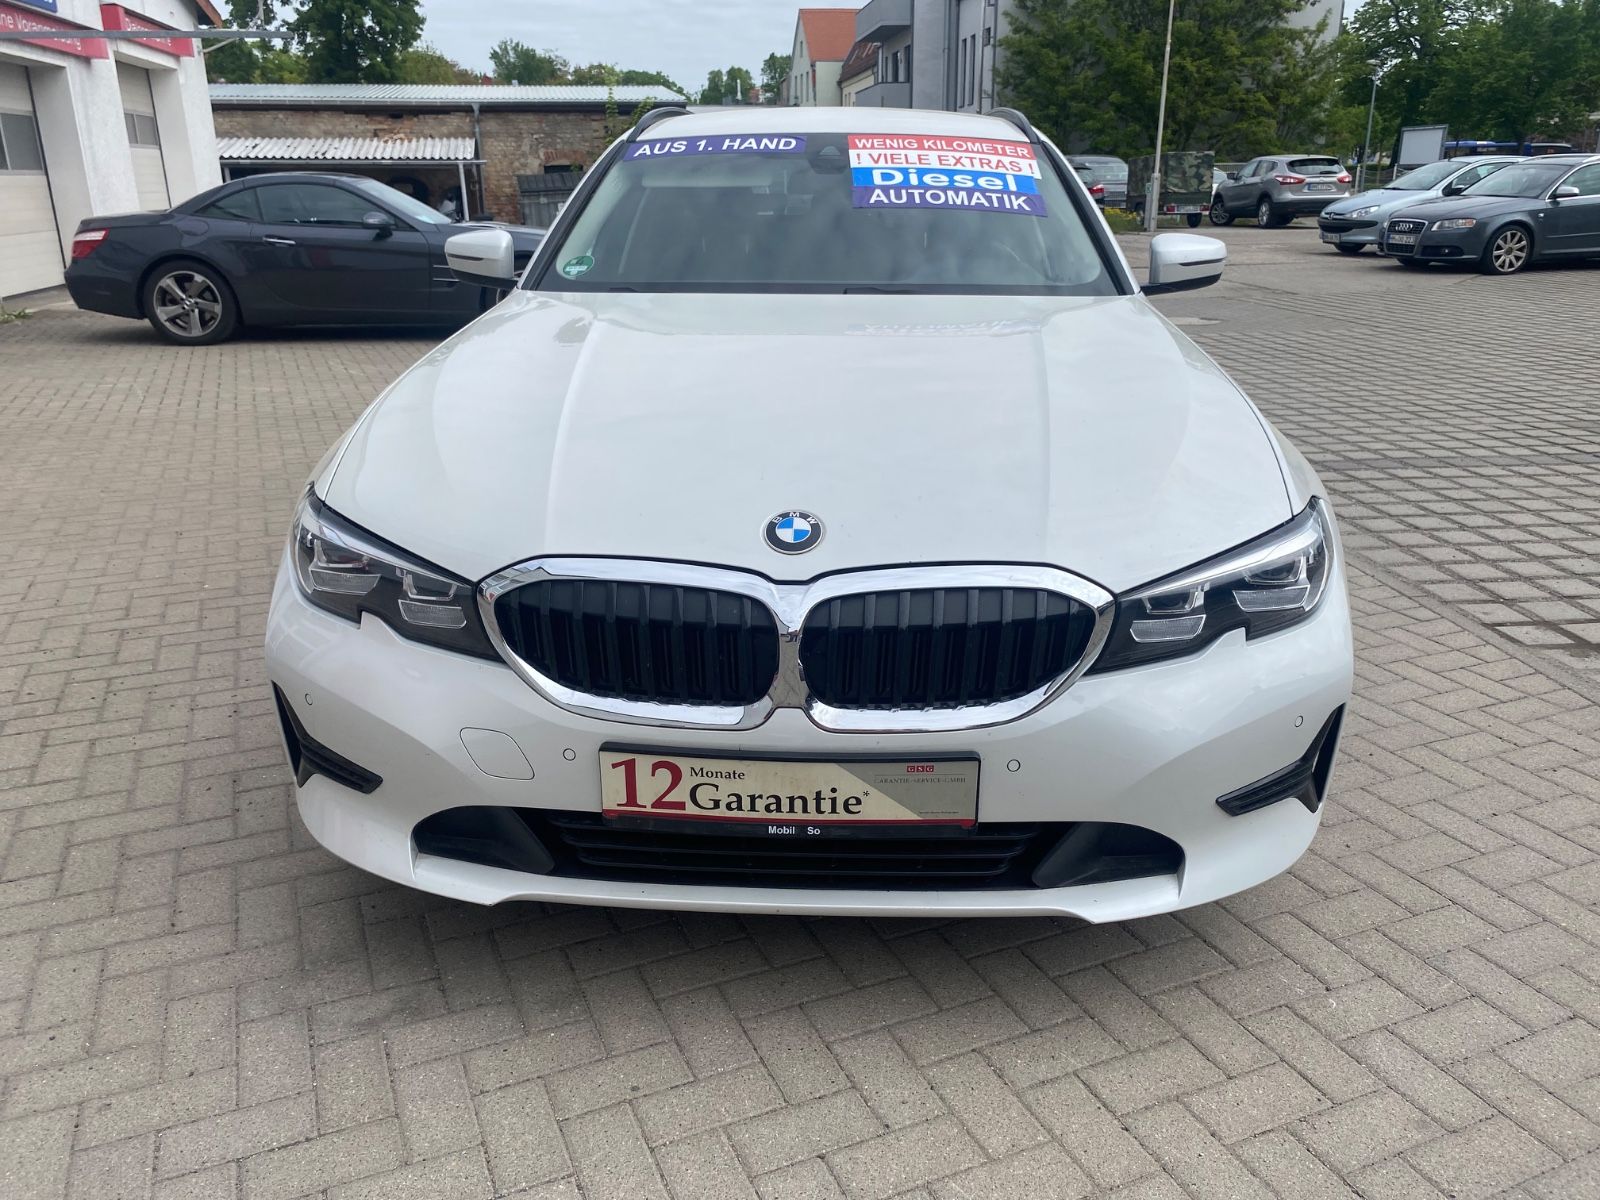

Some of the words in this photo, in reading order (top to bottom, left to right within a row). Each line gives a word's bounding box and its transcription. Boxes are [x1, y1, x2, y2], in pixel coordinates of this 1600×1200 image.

[634, 141, 688, 157] AUS
[696, 139, 713, 151] 1.
[722, 138, 797, 151] HAND
[855, 138, 918, 149] WENIG
[923, 140, 1031, 158] KILOMETER
[868, 153, 931, 165] VIELE
[937, 155, 1022, 172] EXTRAS
[872, 169, 1018, 191] Diesel
[869, 189, 1031, 211] AUTOMATIK
[772, 511, 819, 525] BMW
[689, 766, 745, 780] Monate
[907, 765, 934, 773] GSG
[611, 758, 686, 811] 12
[768, 825, 795, 835] Mobil
[807, 826, 821, 835] So
